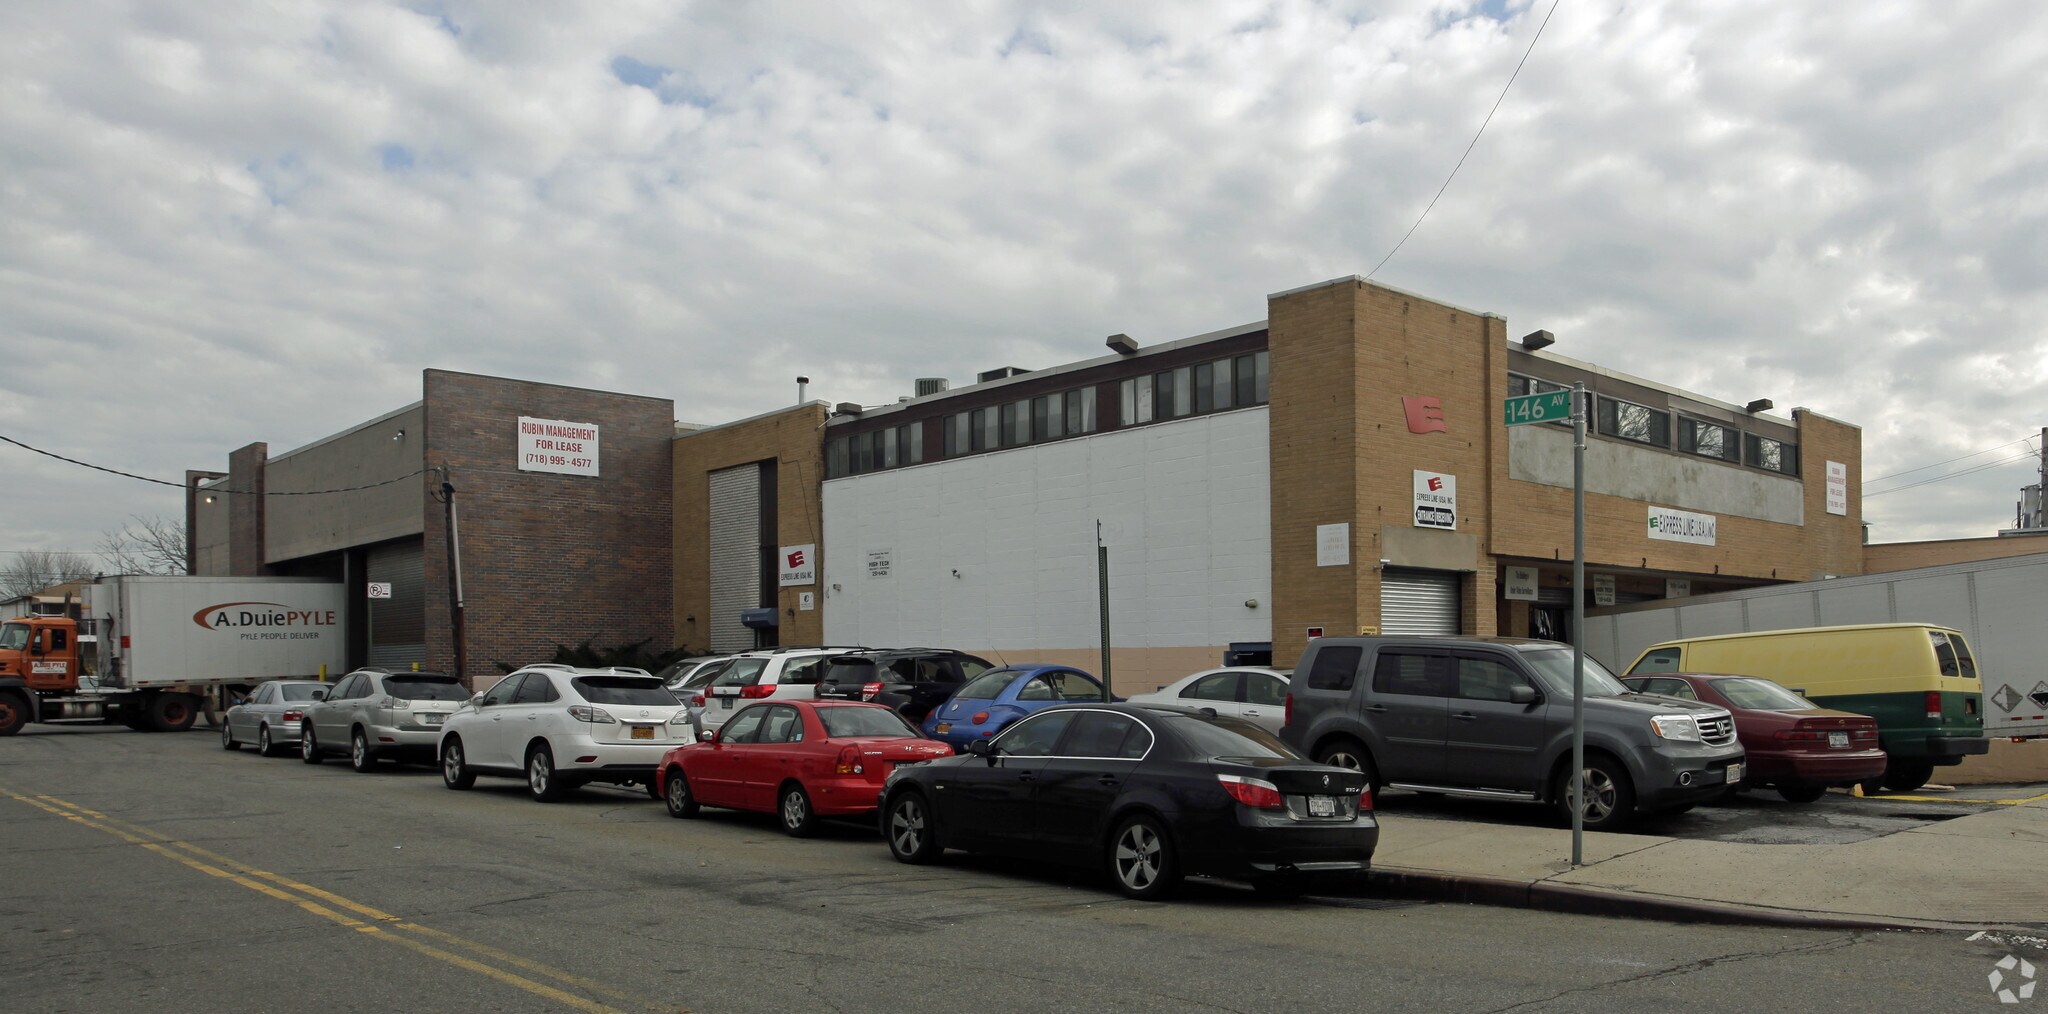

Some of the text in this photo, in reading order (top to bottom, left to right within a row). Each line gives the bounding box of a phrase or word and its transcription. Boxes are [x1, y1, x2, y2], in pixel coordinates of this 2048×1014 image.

[1510, 394, 1565, 422] 146 AV
[521, 422, 596, 441] RUBIN MANAGEMENT
[536, 439, 583, 453] FOR LEASE
[526, 453, 548, 466] (718)
[1416, 492, 1430, 502] EXPRESS
[1660, 514, 1682, 536] EXPRESS
[1684, 518, 1694, 536] LINE
[1555, 548, 1558, 560] 1
[1642, 558, 1646, 568] 2
[1714, 564, 1719, 574] 3
[1772, 568, 1776, 578] 4
